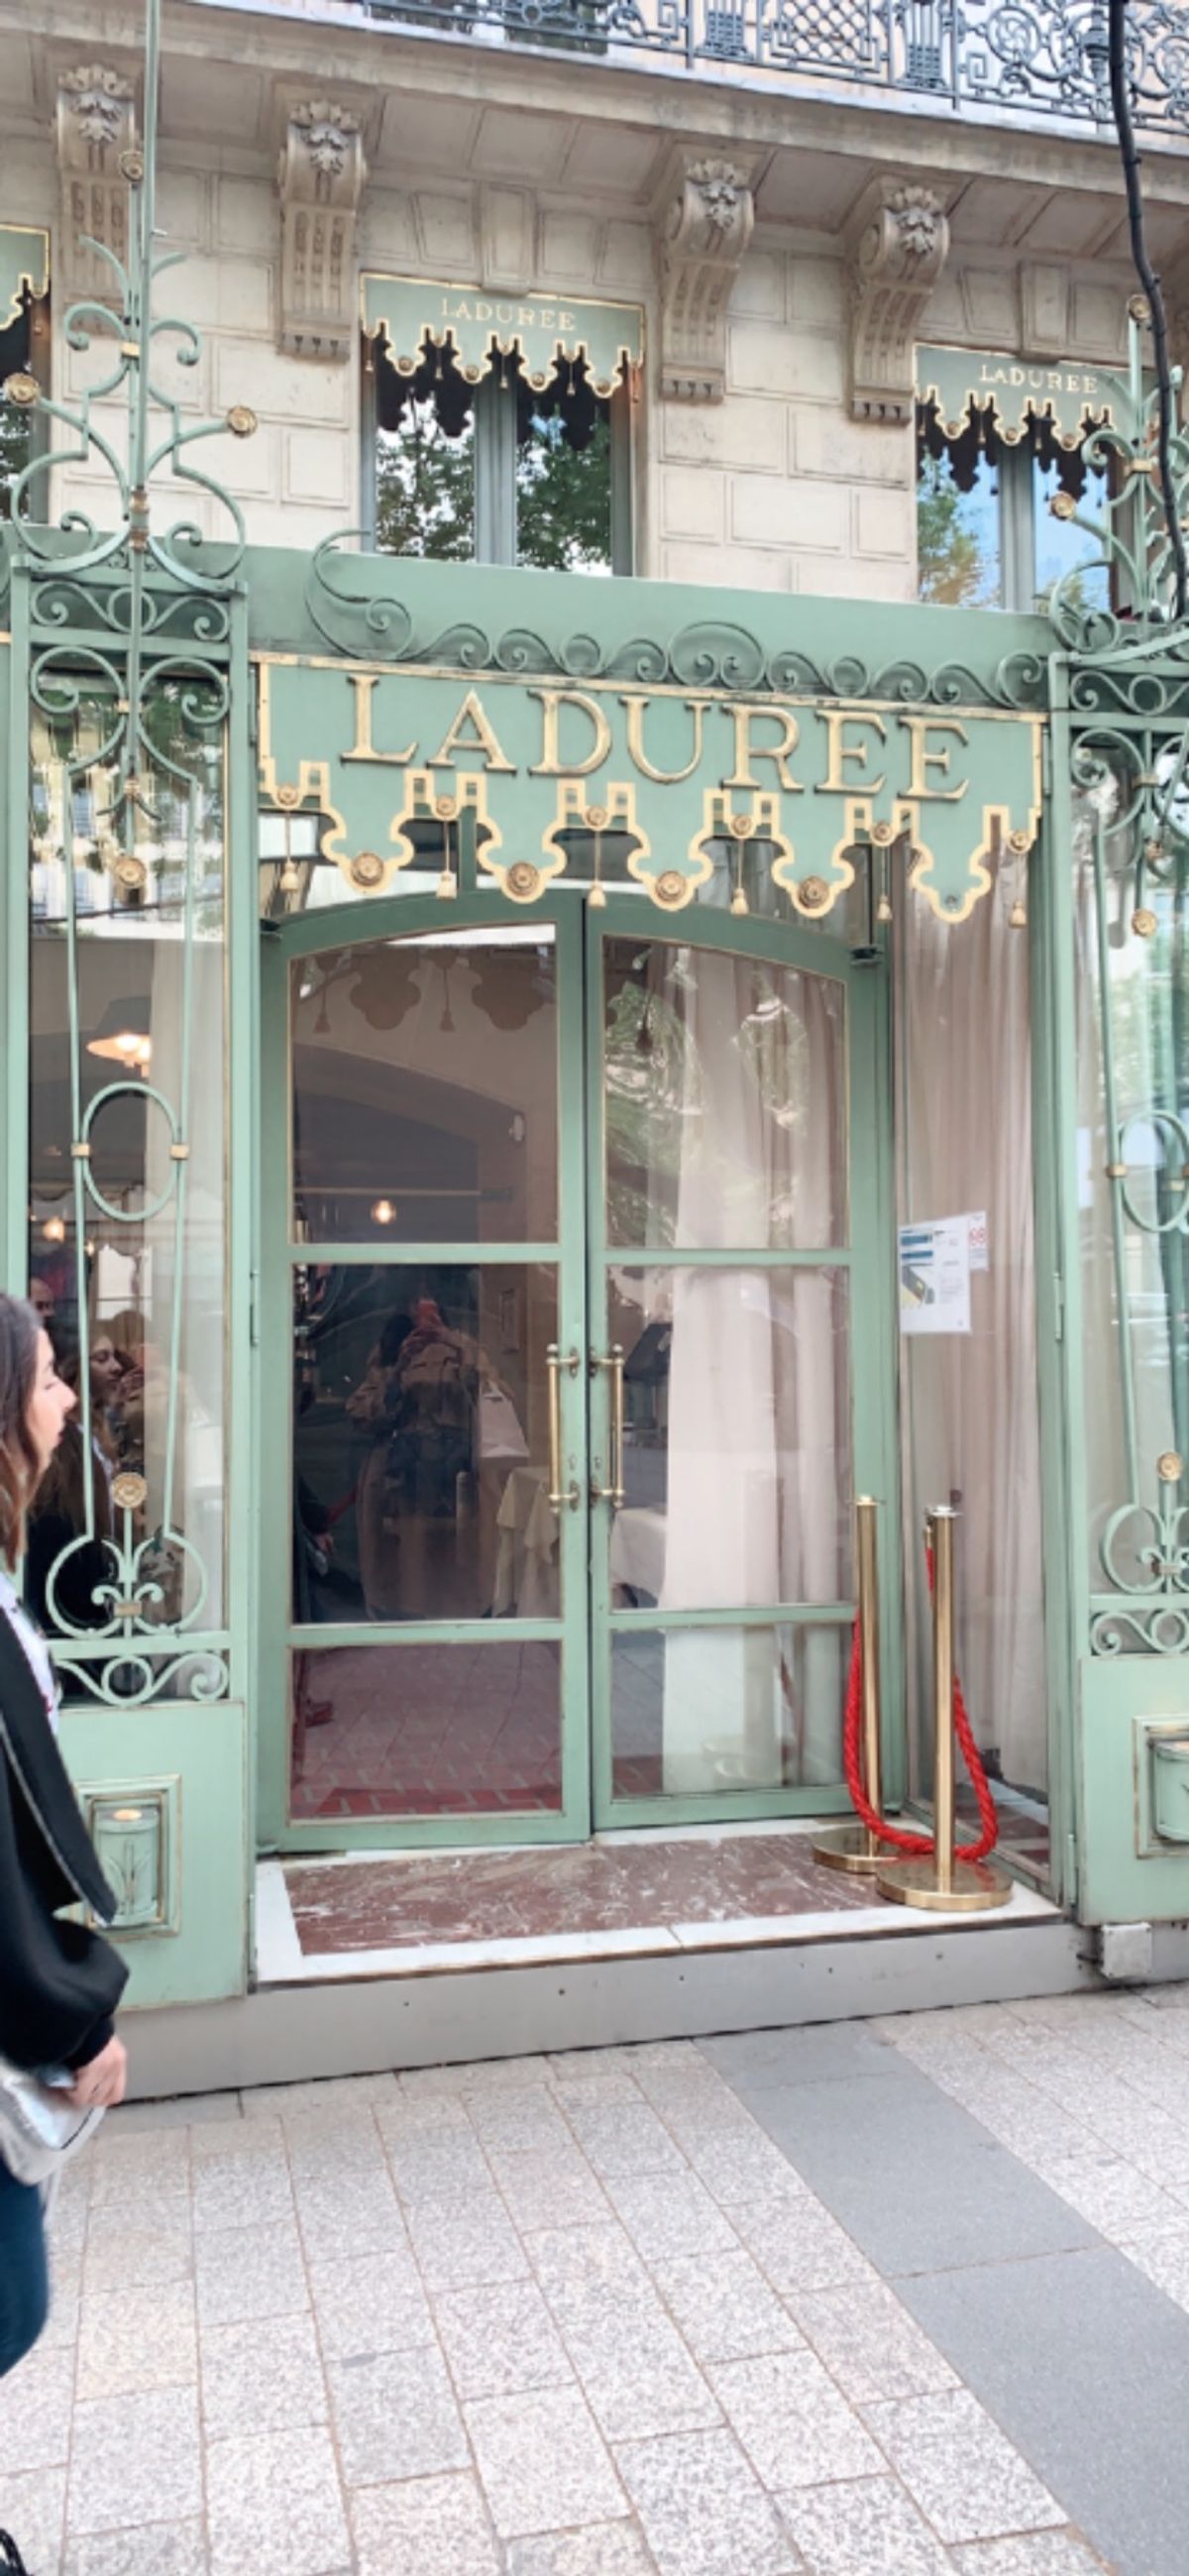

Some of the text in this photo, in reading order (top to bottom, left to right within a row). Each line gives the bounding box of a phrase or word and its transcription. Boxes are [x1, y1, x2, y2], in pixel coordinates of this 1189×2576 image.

[440, 298, 577, 331] LADUREE
[979, 364, 1098, 393] LADUREE
[339, 674, 970, 801] LADUREE
